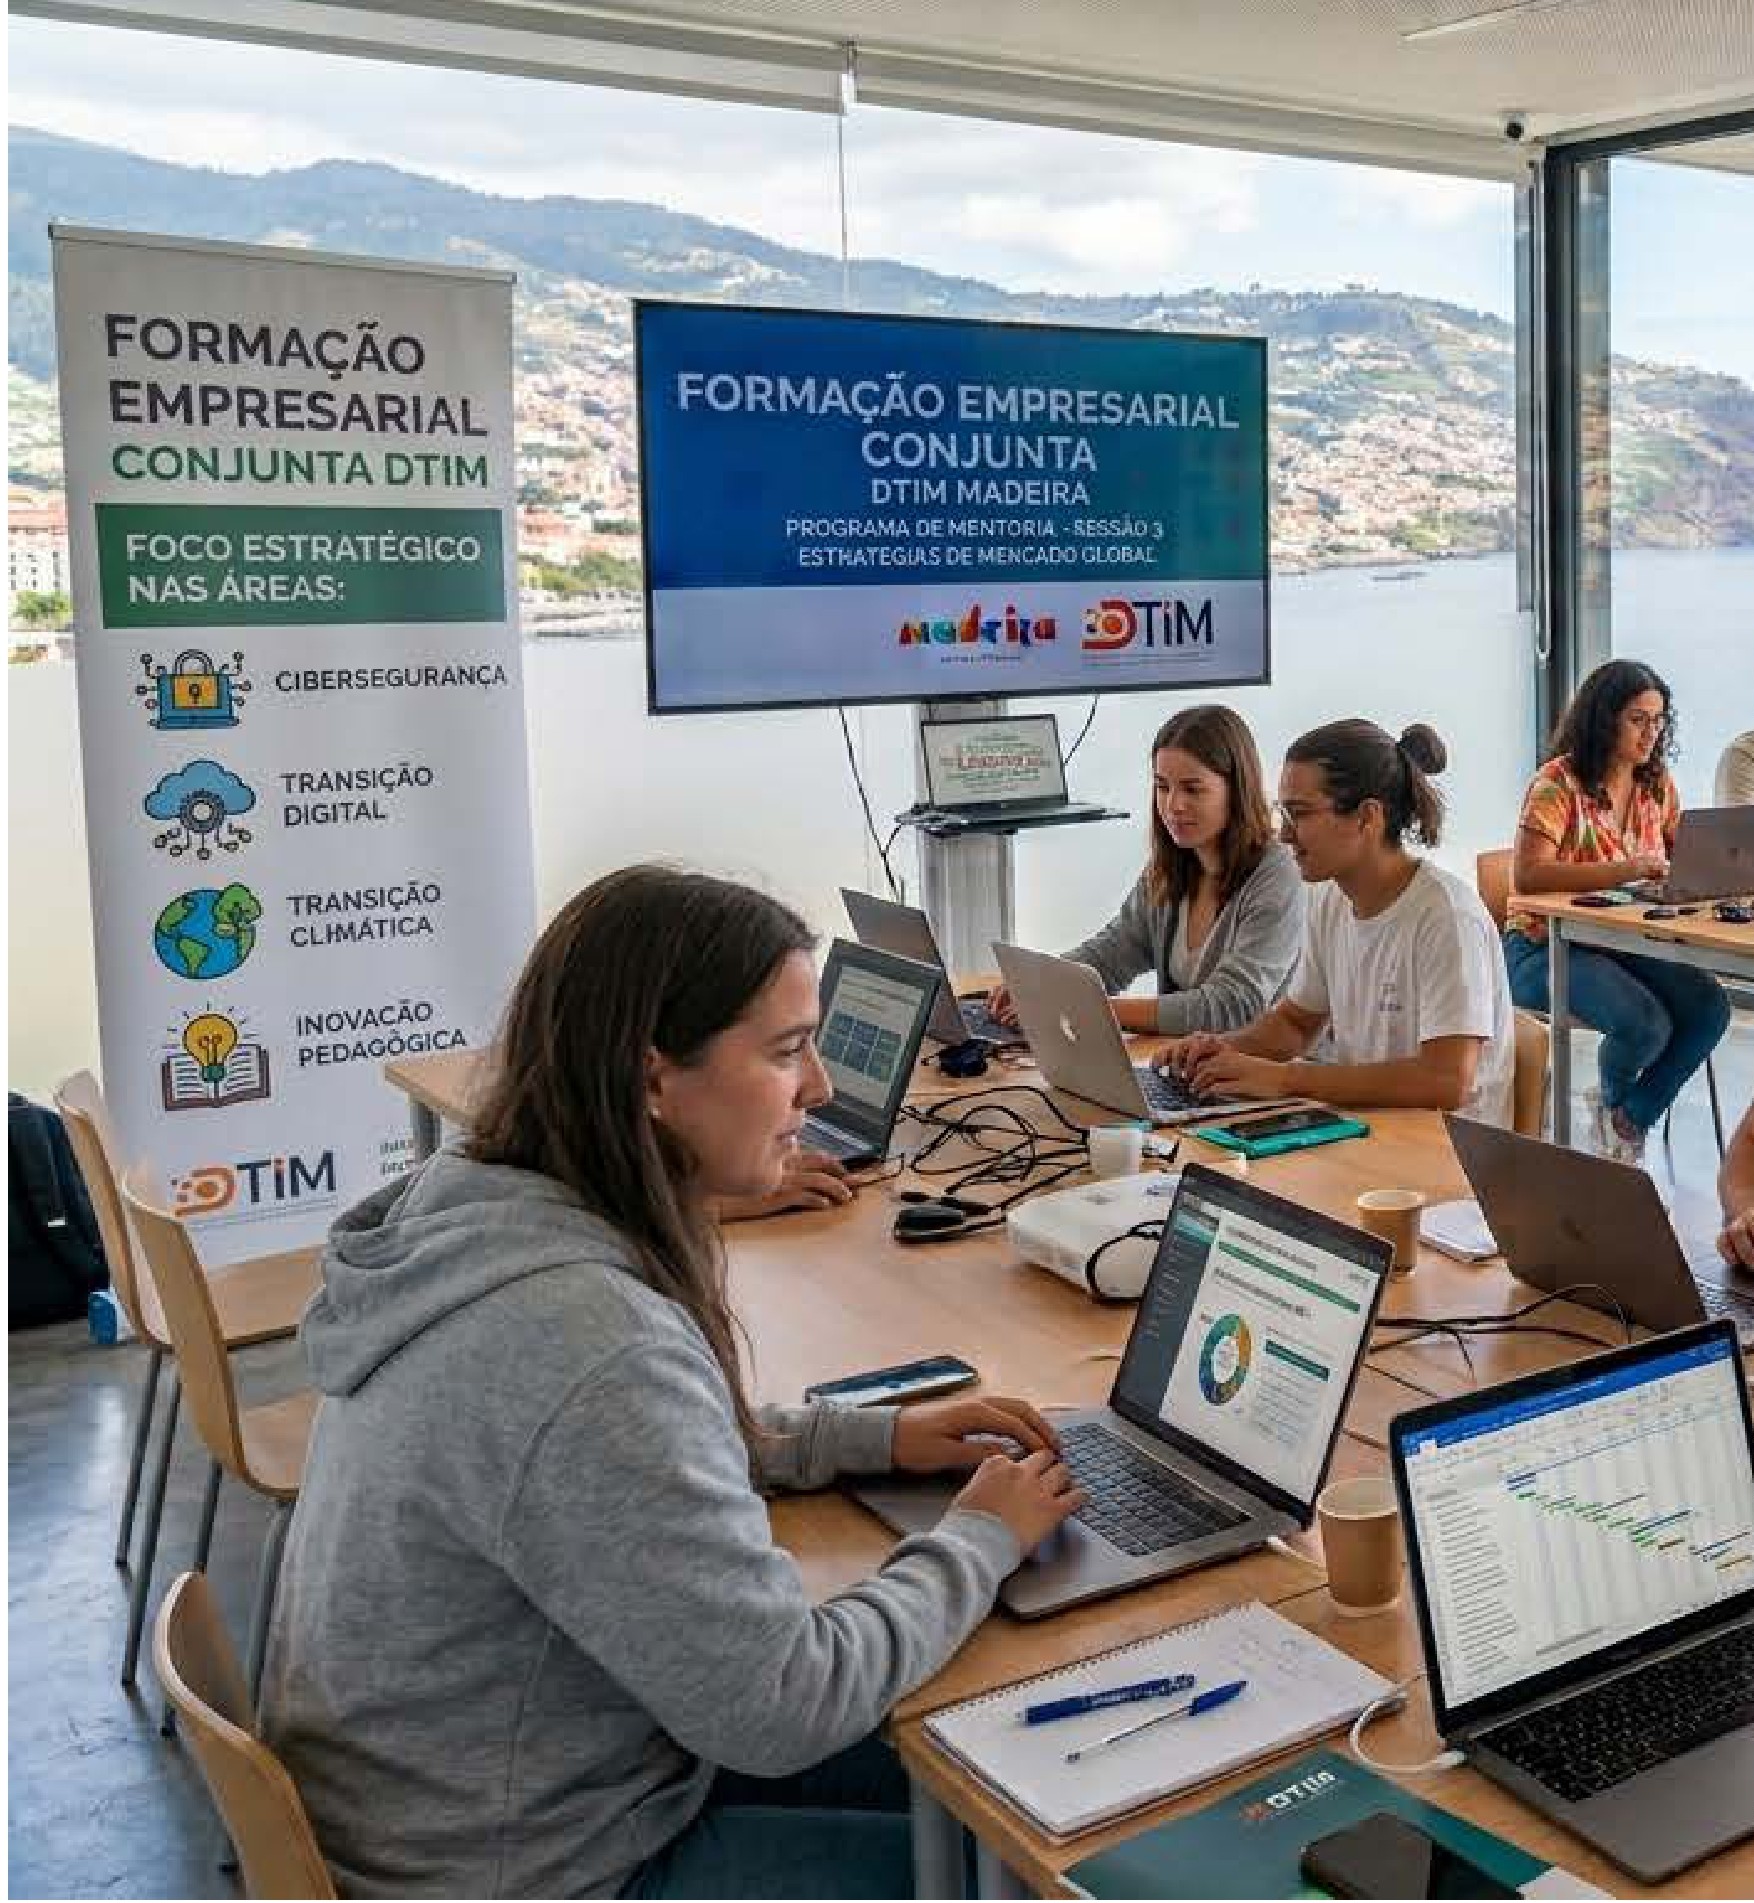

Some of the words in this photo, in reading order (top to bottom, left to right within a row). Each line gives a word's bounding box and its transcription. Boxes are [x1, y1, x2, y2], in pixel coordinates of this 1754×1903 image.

[104, 313, 424, 379] FORMAÇÃO
[109, 380, 488, 436] EMPRESARIAL
[677, 370, 944, 424] FORMAÇÃO
[959, 383, 1239, 429] EMPRESARIAL
[112, 443, 373, 485] CONJUNTA
[385, 452, 488, 488] DTIM
[861, 430, 1097, 471] CONJUNTA
[871, 478, 947, 504] DTIM
[957, 478, 1091, 505] MADEIRA
[785, 518, 910, 538] PROGRAMA
[915, 518, 944, 538] DE
[948, 518, 1054, 538] MENTORIA
[126, 534, 232, 561] FOCO
[243, 529, 481, 562] ESTRATÉGICO
[946, 546, 974, 566] DE
[1082, 546, 1158, 563] GLOBAL
[128, 574, 208, 602] NAS
[218, 569, 345, 601] ÁREAS:
[275, 664, 505, 692] CIBERSEGURANÇA
[279, 761, 433, 794] TRANSIÇÃO
[284, 800, 386, 827] DIGITAL
[286, 880, 441, 917] TRANSIÇÃO
[290, 916, 434, 947] CLIMÁTICA
